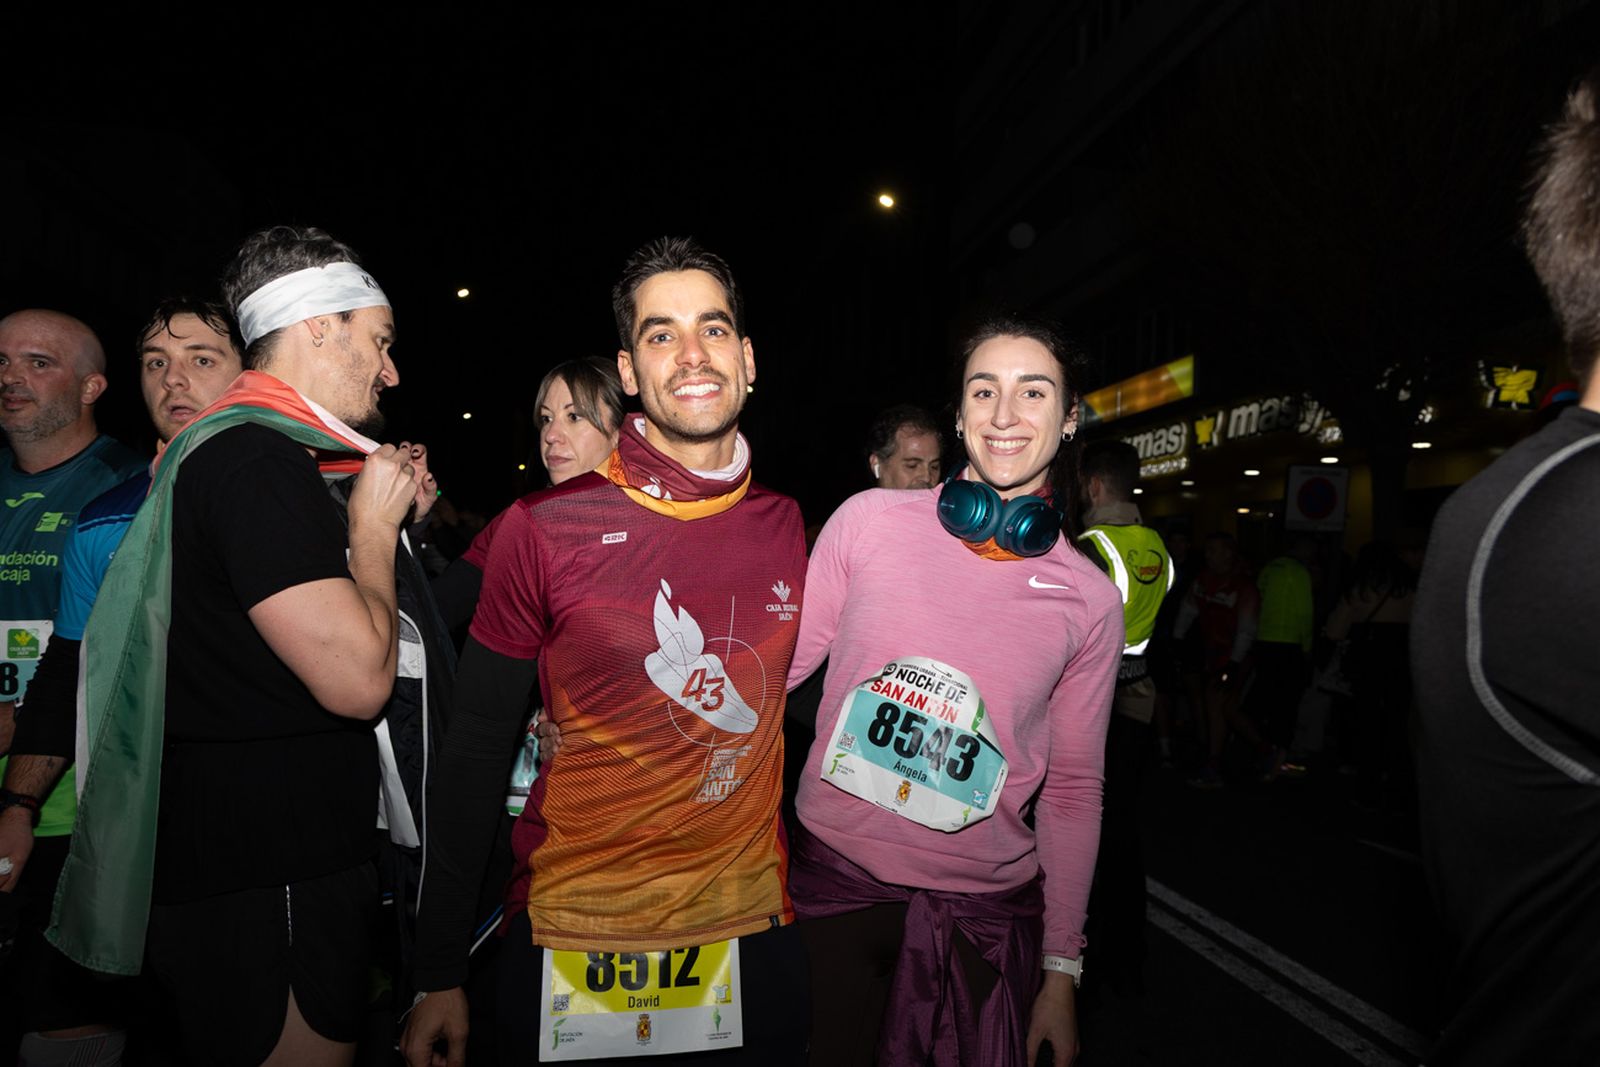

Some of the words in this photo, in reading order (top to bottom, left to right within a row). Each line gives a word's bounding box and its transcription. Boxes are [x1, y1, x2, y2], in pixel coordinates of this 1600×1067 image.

[0, 567, 31, 586] caja
[681, 668, 725, 712] 43
[870, 679, 906, 702] SAN
[895, 668, 945, 695] NOCHE
[944, 684, 967, 704] DE
[868, 701, 981, 783] 8543
[893, 758, 928, 783] Ángela
[585, 945, 700, 993] 8512
[628, 995, 660, 1009] David
